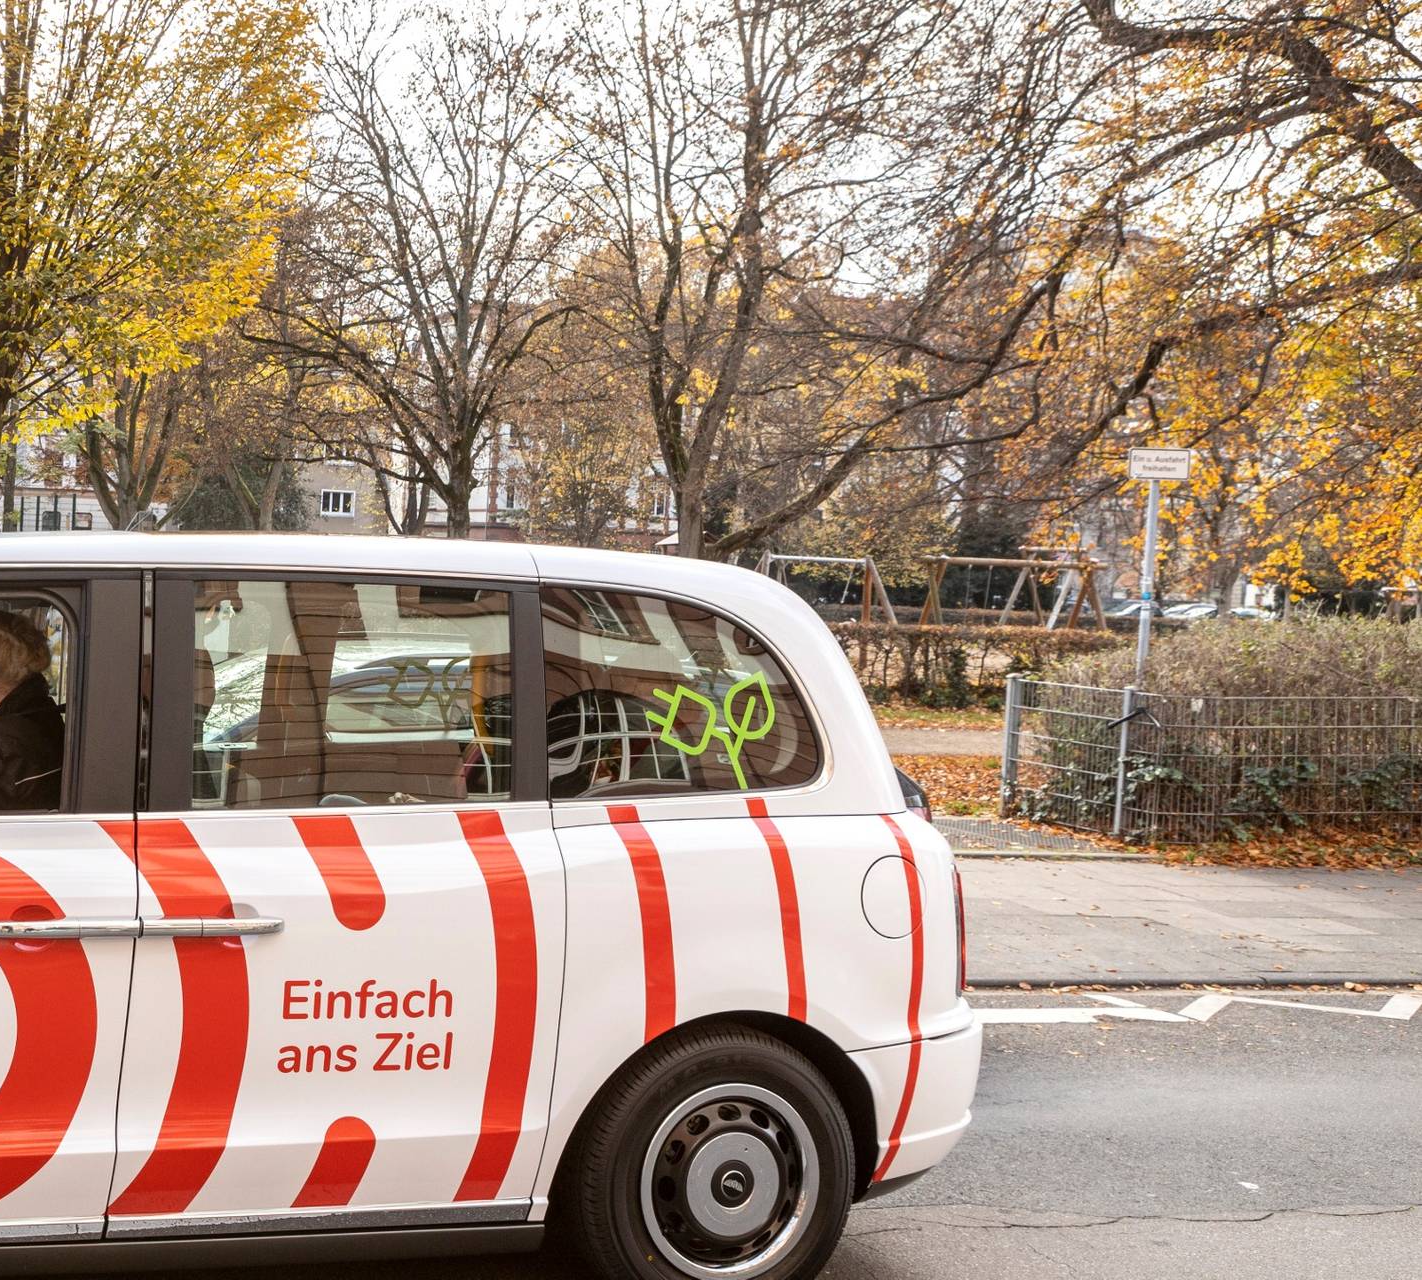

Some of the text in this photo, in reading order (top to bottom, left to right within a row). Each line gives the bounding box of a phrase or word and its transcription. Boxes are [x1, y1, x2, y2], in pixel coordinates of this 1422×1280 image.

[282, 978, 453, 1020] Einfach
[277, 1031, 454, 1074] ans Ziel
